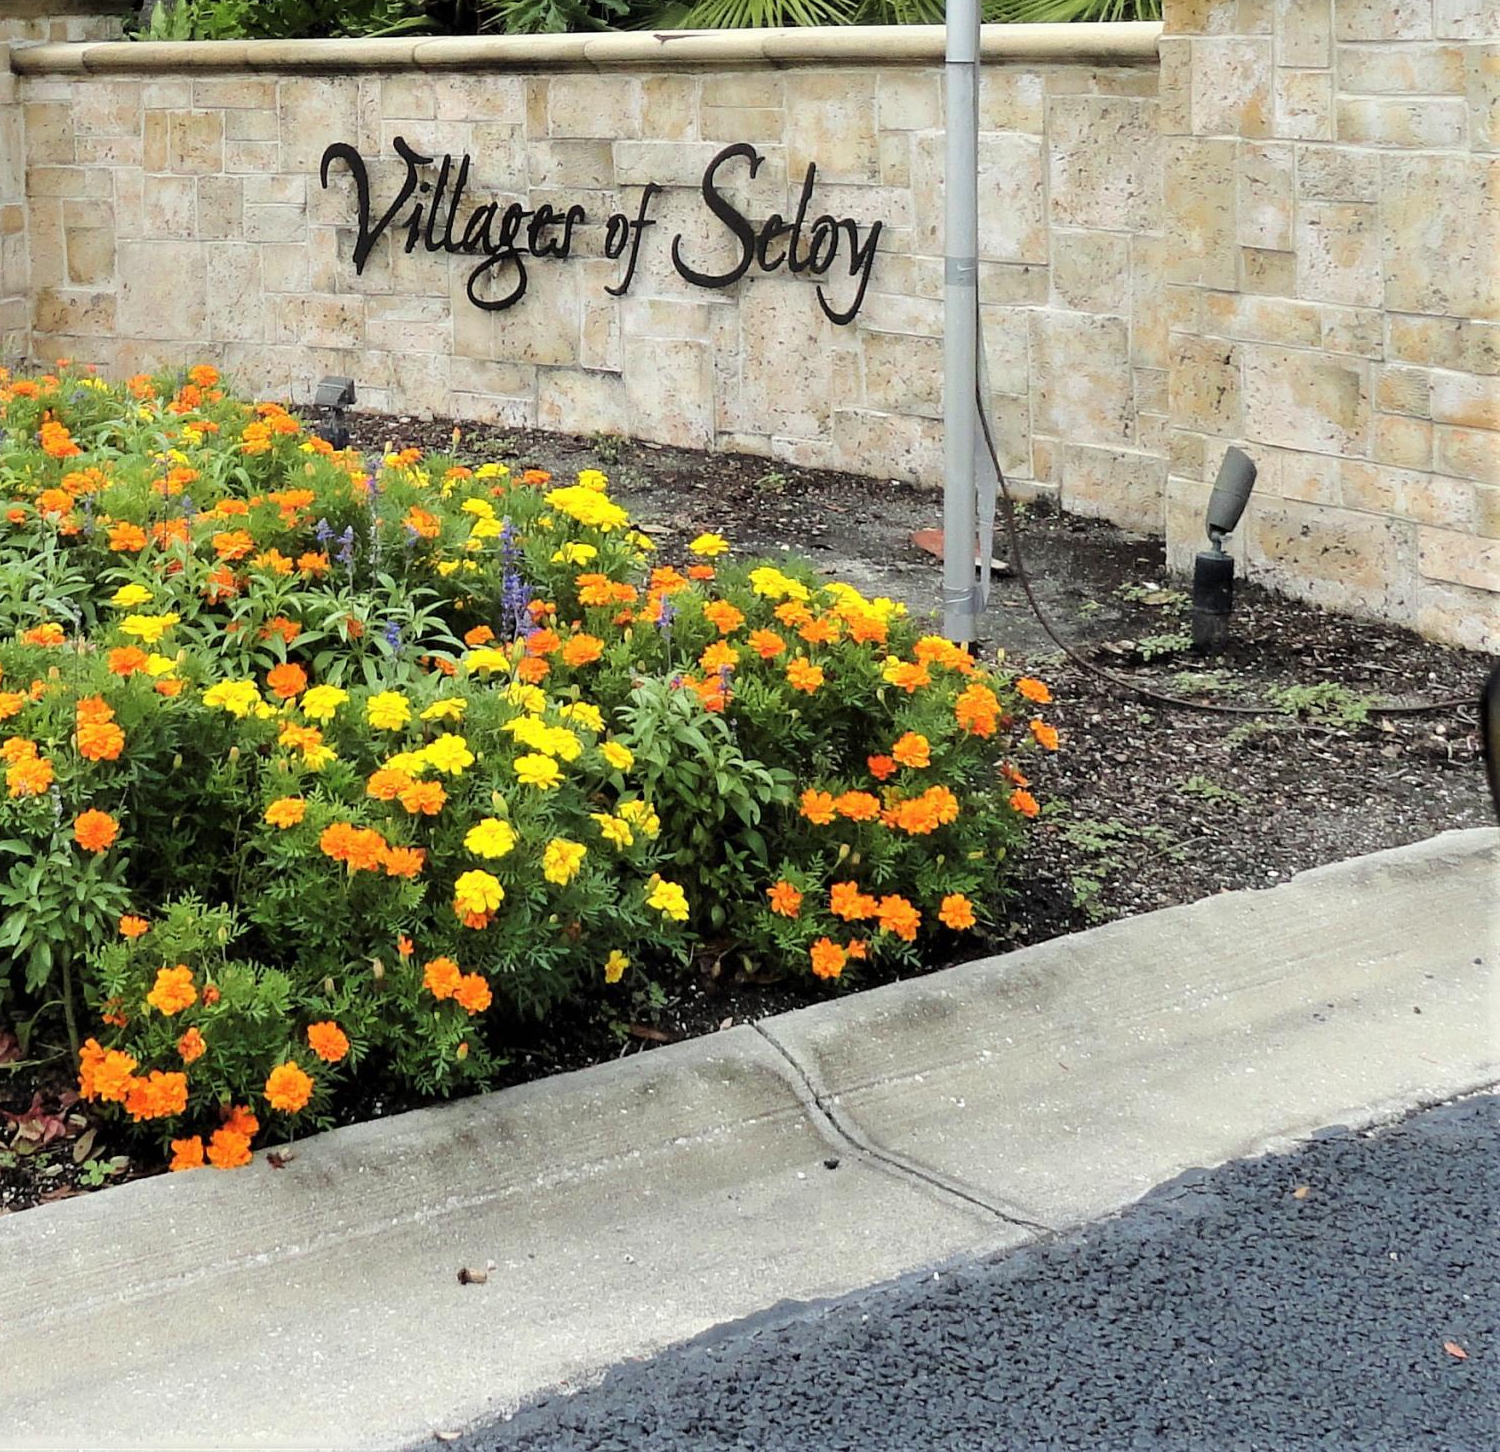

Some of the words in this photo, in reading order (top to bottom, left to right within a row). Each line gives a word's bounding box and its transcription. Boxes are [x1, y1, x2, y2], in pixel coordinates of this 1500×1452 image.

[320, 136, 586, 311] Villages
[604, 182, 664, 296] of
[672, 142, 883, 326] Seloy
